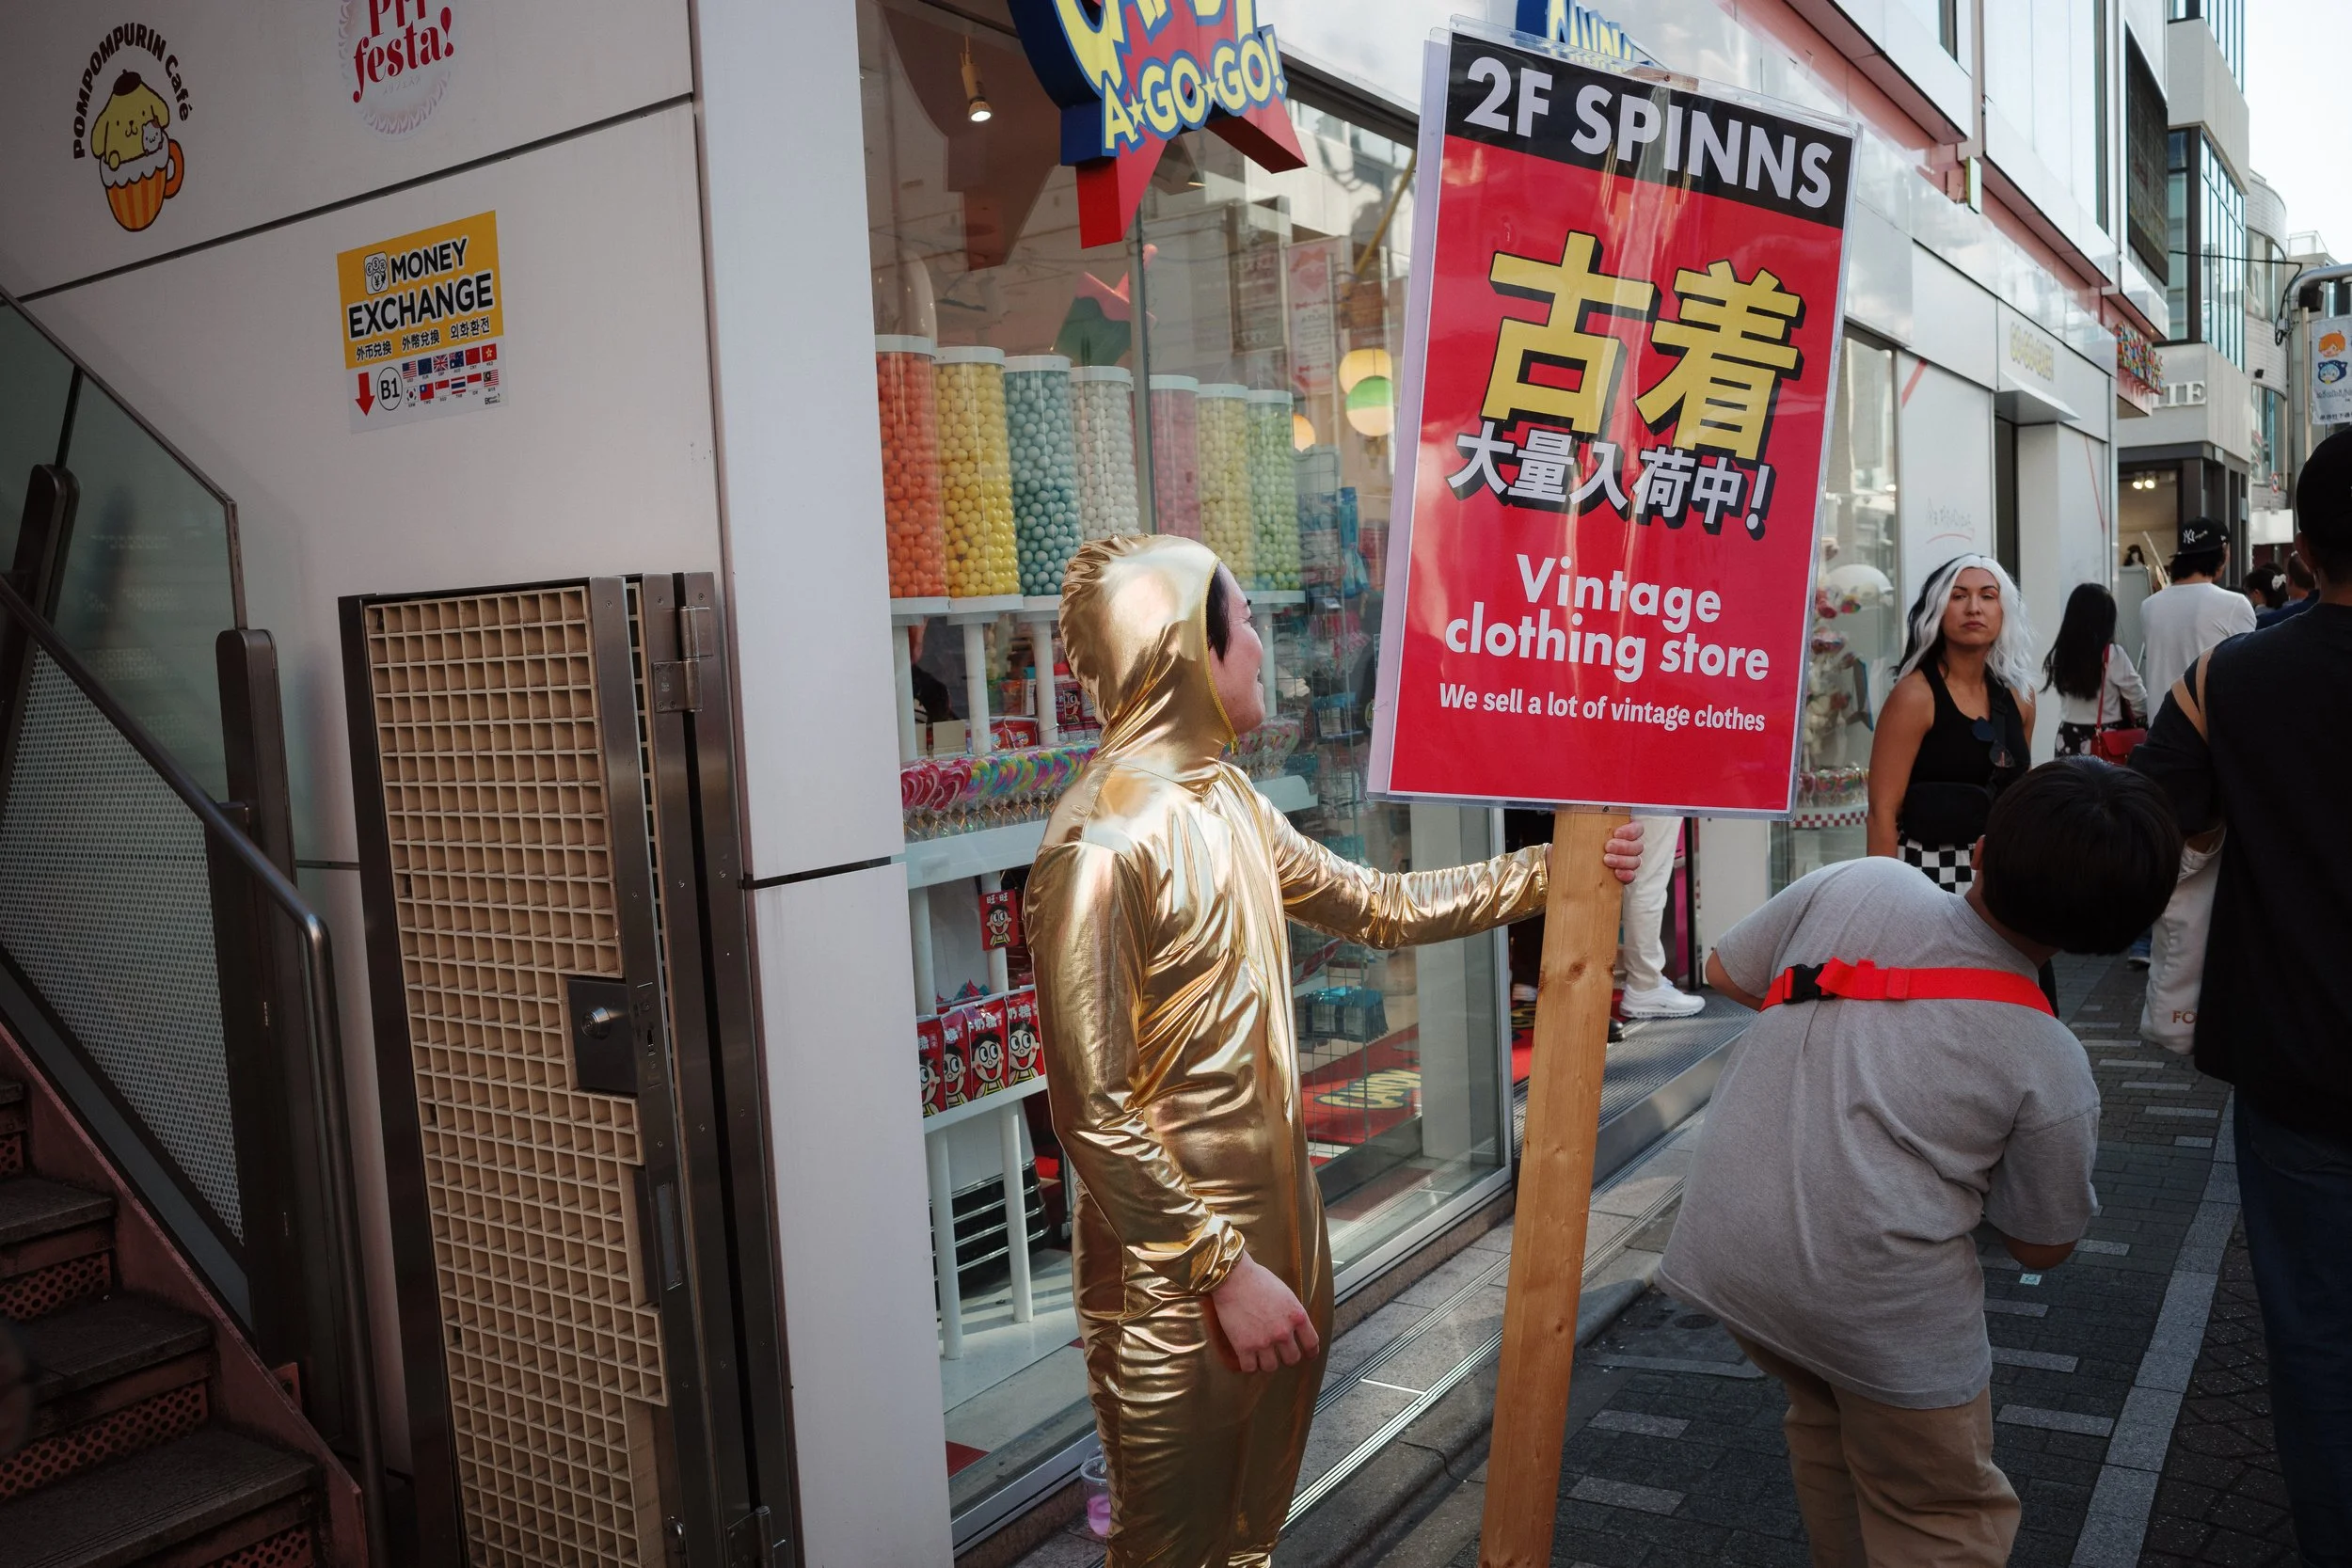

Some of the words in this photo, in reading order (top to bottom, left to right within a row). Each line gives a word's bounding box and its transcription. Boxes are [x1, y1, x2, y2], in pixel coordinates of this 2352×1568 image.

[73, 22, 167, 159] POMPOMPURIN
[165, 55, 193, 121] Café
[353, 7, 453, 103] festa!
[1464, 56, 1553, 138] 2F
[1571, 85, 1833, 209] SPINNS
[390, 238, 468, 284] MONEY
[348, 273, 494, 339] EXCHANGE
[450, 316, 490, 340] 외화환전
[1479, 230, 1804, 461] 古着
[380, 377, 400, 401] B1
[1446, 420, 1772, 531] 大量入荷中!
[1516, 554, 1721, 634] Vintage
[1445, 602, 1645, 683] clothing
[1660, 634, 1770, 680] store
[1439, 683, 1478, 710] We
[1483, 688, 1523, 714] sell
[1528, 695, 1542, 715] a
[1548, 691, 1579, 719] lot
[1582, 696, 1607, 721] of
[1611, 701, 1690, 733] vintage
[1694, 704, 1766, 733] clothes
